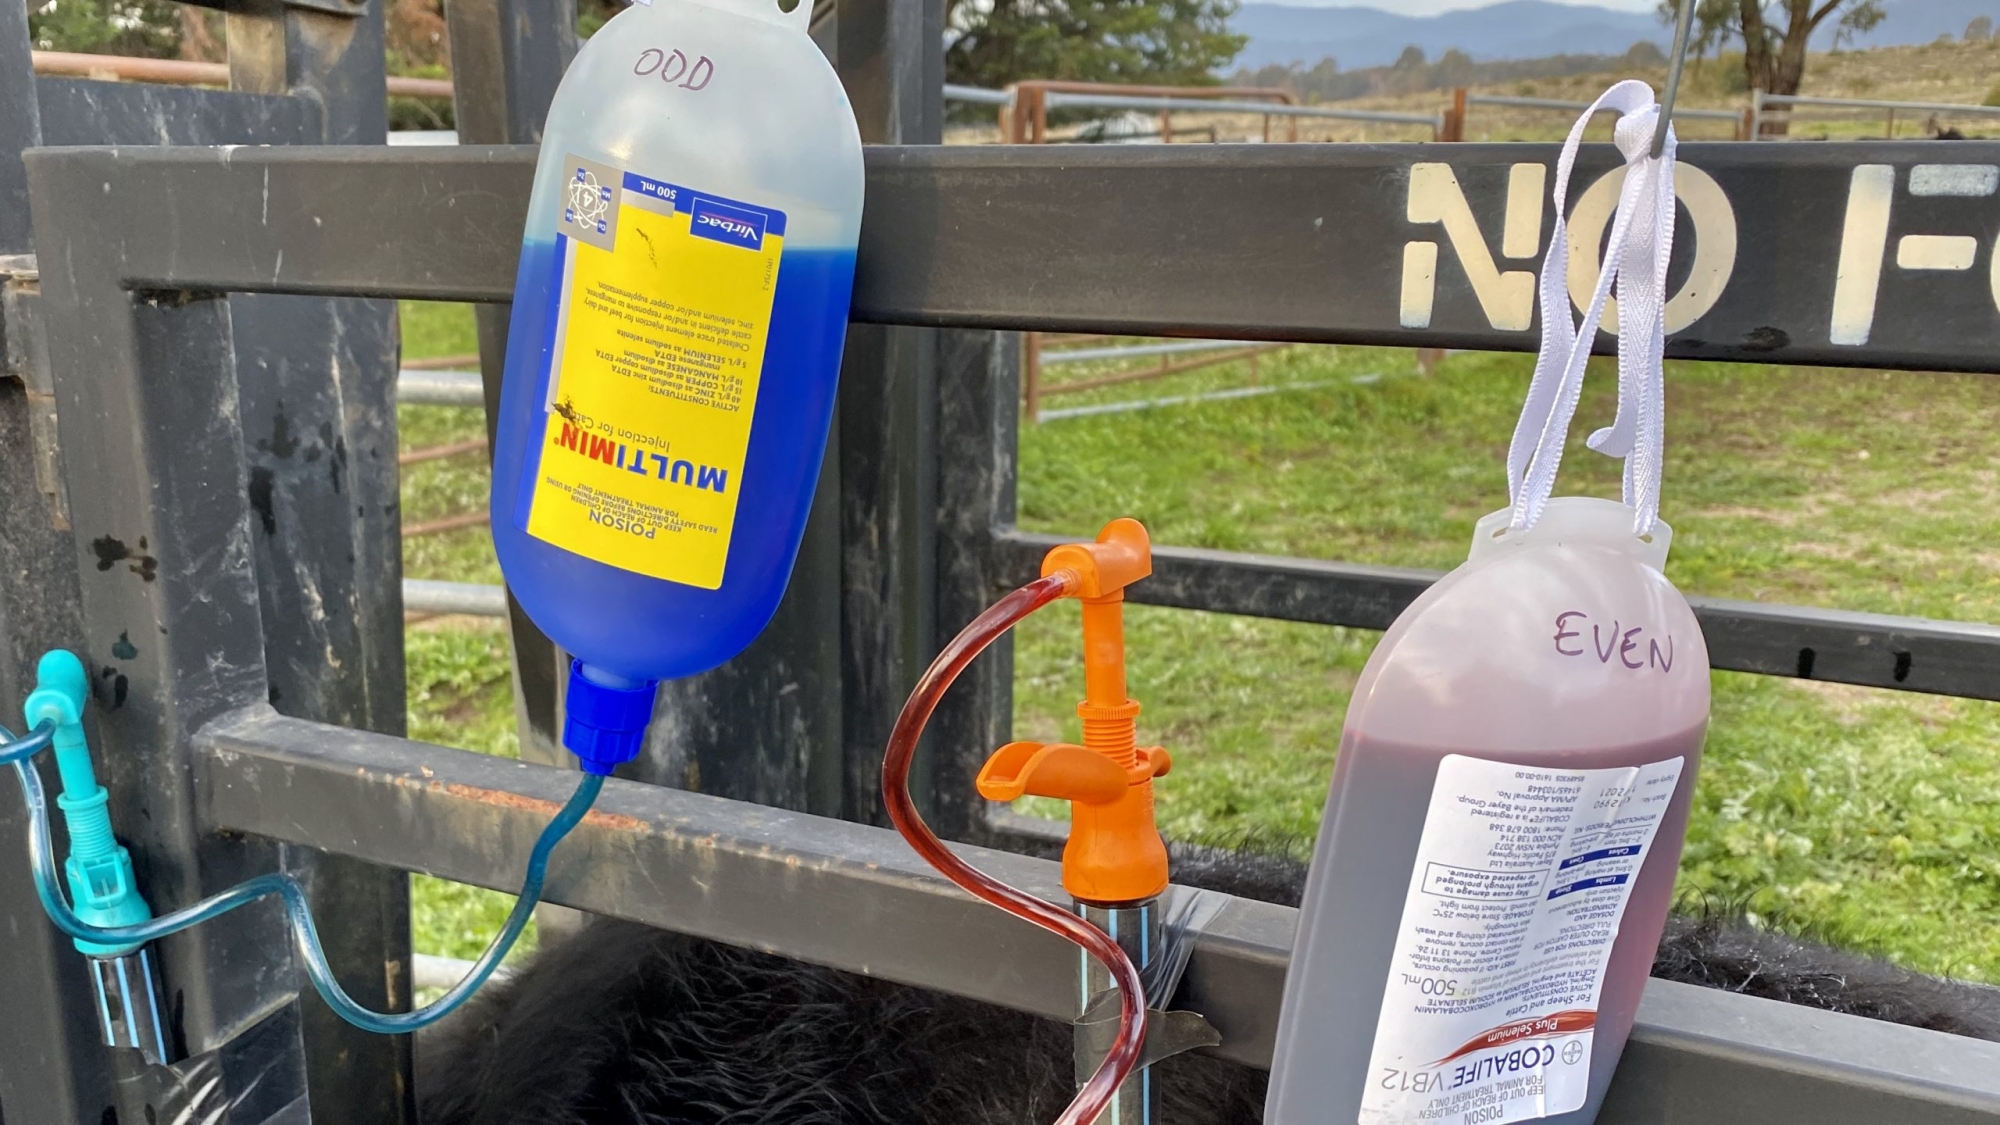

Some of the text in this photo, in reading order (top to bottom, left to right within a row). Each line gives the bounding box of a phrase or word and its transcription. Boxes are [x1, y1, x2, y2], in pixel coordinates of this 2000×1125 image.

[640, 180, 677, 200] 500 mL
[583, 191, 594, 207] 4
[697, 215, 758, 241] Virbac
[1400, 162, 2000, 346] NO F
[625, 301, 661, 317] responsive
[649, 297, 674, 309] copper
[676, 306, 701, 318] and/or
[703, 312, 734, 325] selenium
[583, 296, 749, 351] Chelated trace element injection for beef and dairy
[662, 313, 688, 325] and/or
[615, 328, 643, 342] selenite
[698, 322, 729, 335] deficient
[731, 330, 751, 340] cattle
[644, 337, 671, 350] sodium
[594, 348, 613, 361] EDTA
[615, 355, 638, 367] copper
[622, 350, 655, 364] disodium
[653, 349, 720, 369] manganese EDTA
[683, 348, 725, 363] SELENIUM
[727, 357, 741, 366] g/L
[611, 364, 631, 375] EDTA
[631, 371, 647, 380] zinc
[639, 364, 673, 379] disodium
[665, 362, 719, 380] MANGANESE
[648, 375, 682, 390] disodium
[685, 376, 718, 389] COPPER
[720, 373, 734, 383] g/L
[694, 387, 715, 397] ZINC
[719, 382, 733, 392] g/L
[716, 391, 731, 400] g/L
[732, 395, 740, 403] 40
[711, 400, 739, 411] ACTIVE
[596, 421, 613, 436] for
[616, 427, 670, 452] Injection
[545, 476, 562, 489] USING
[572, 488, 599, 503] OPENING
[576, 482, 678, 517] FOR ANIMAL TREATMENT ONLY
[600, 498, 625, 511] BEFORE
[570, 494, 681, 532] KEEP OUT OF REACH OF CHILDREN
[626, 506, 668, 522] DIRECTIONS
[588, 509, 655, 539] POISON
[670, 517, 696, 528] SAFETY
[698, 524, 717, 533] READ
[1553, 611, 1673, 673] EVEN
[1456, 794, 1486, 807] Group.
[1496, 790, 1511, 799] No.
[1513, 792, 1549, 802] Approval
[1488, 801, 1511, 810] Bayer
[1514, 804, 1526, 812] the
[1470, 808, 1513, 819] registered
[1494, 842, 1513, 850] 2073
[1487, 849, 1520, 858] Highway
[1447, 869, 1489, 880] exposure.
[1491, 874, 1526, 882] repeated
[1435, 876, 1538, 891] organs through prolonged
[1456, 887, 1489, 897] damage
[1569, 983, 1593, 991] ACTIVE
[1505, 993, 1590, 1017] For Sheep and Cattle
[1487, 1018, 1558, 1042] Plus Selenium
[1381, 1067, 1443, 1093] VB12
[1427, 1074, 1543, 1108] FOR ANIMAL TREATMENT ONLY
[1418, 1084, 1543, 1118] EEP OUT OF REACH OF CHILDREN
[1464, 1104, 1503, 1124] POISON
